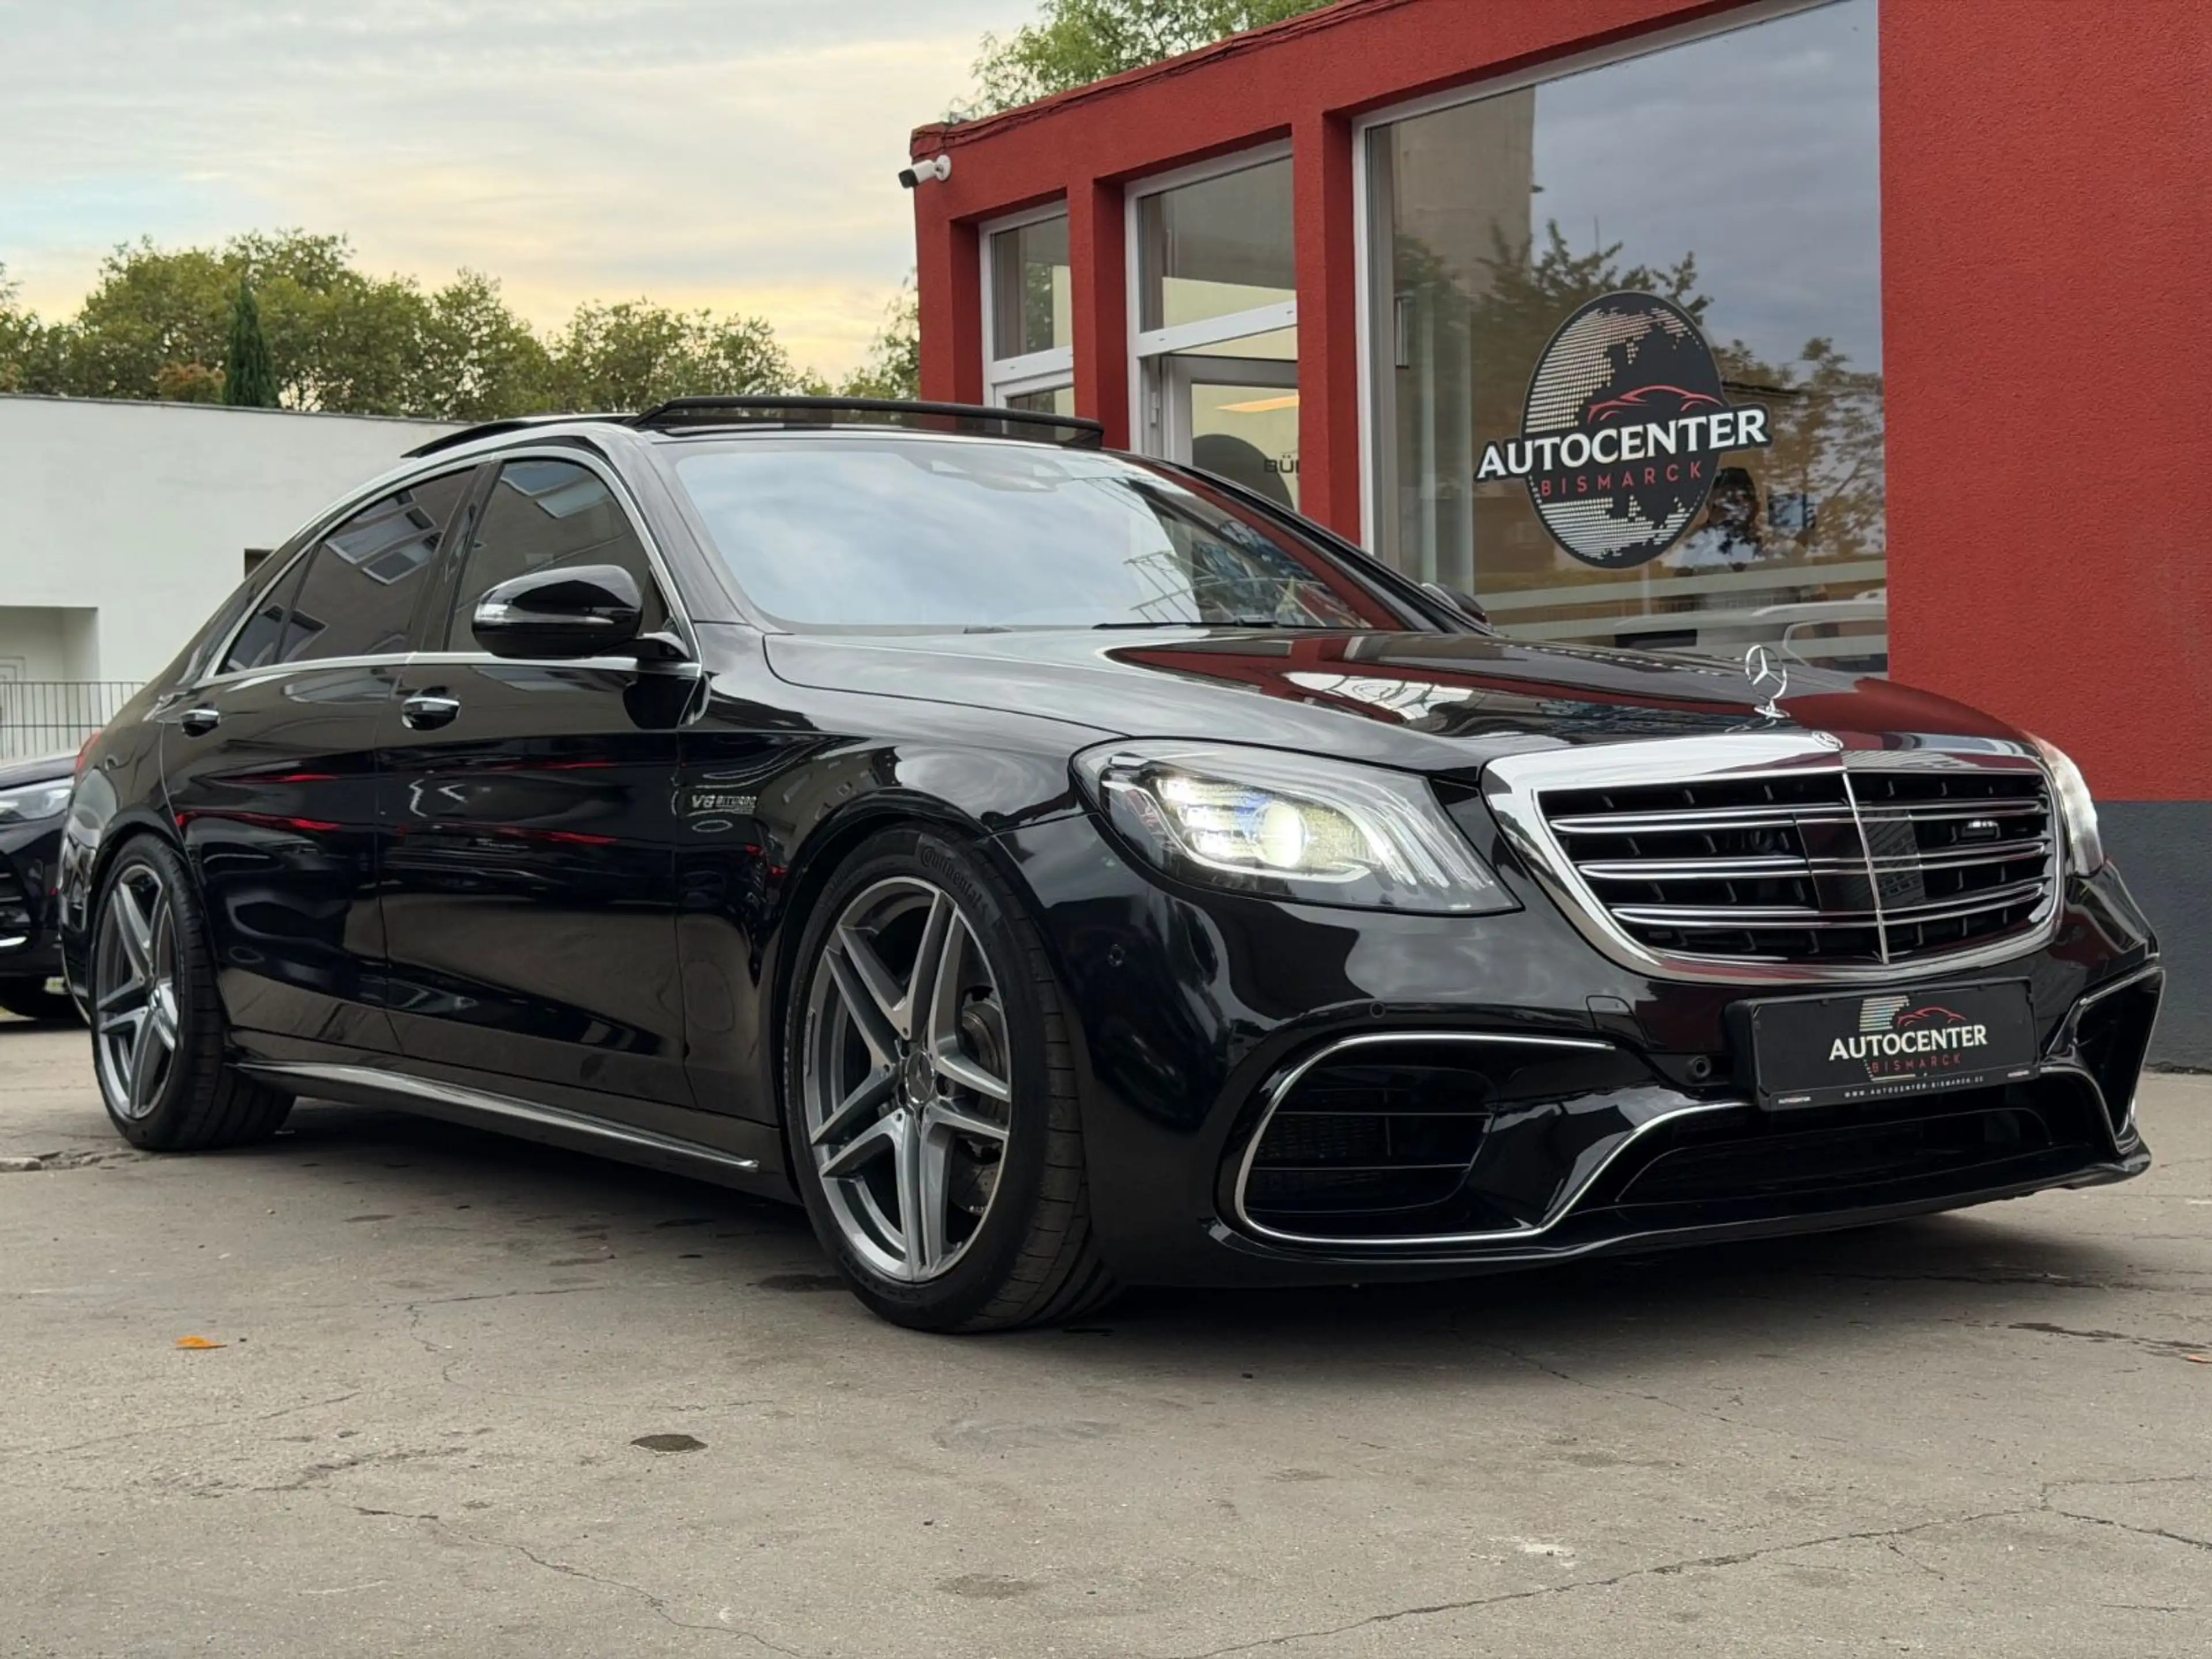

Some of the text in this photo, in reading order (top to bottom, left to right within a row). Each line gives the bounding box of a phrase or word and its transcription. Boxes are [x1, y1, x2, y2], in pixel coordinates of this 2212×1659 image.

[1476, 408, 1768, 479] AUTOCENTER
[1541, 461, 1702, 497] BISMARCK
[921, 846, 983, 910] Continental
[1828, 1024, 1988, 1061] AUTOCENTER
[1872, 1053, 1961, 1073] BISMARCK
